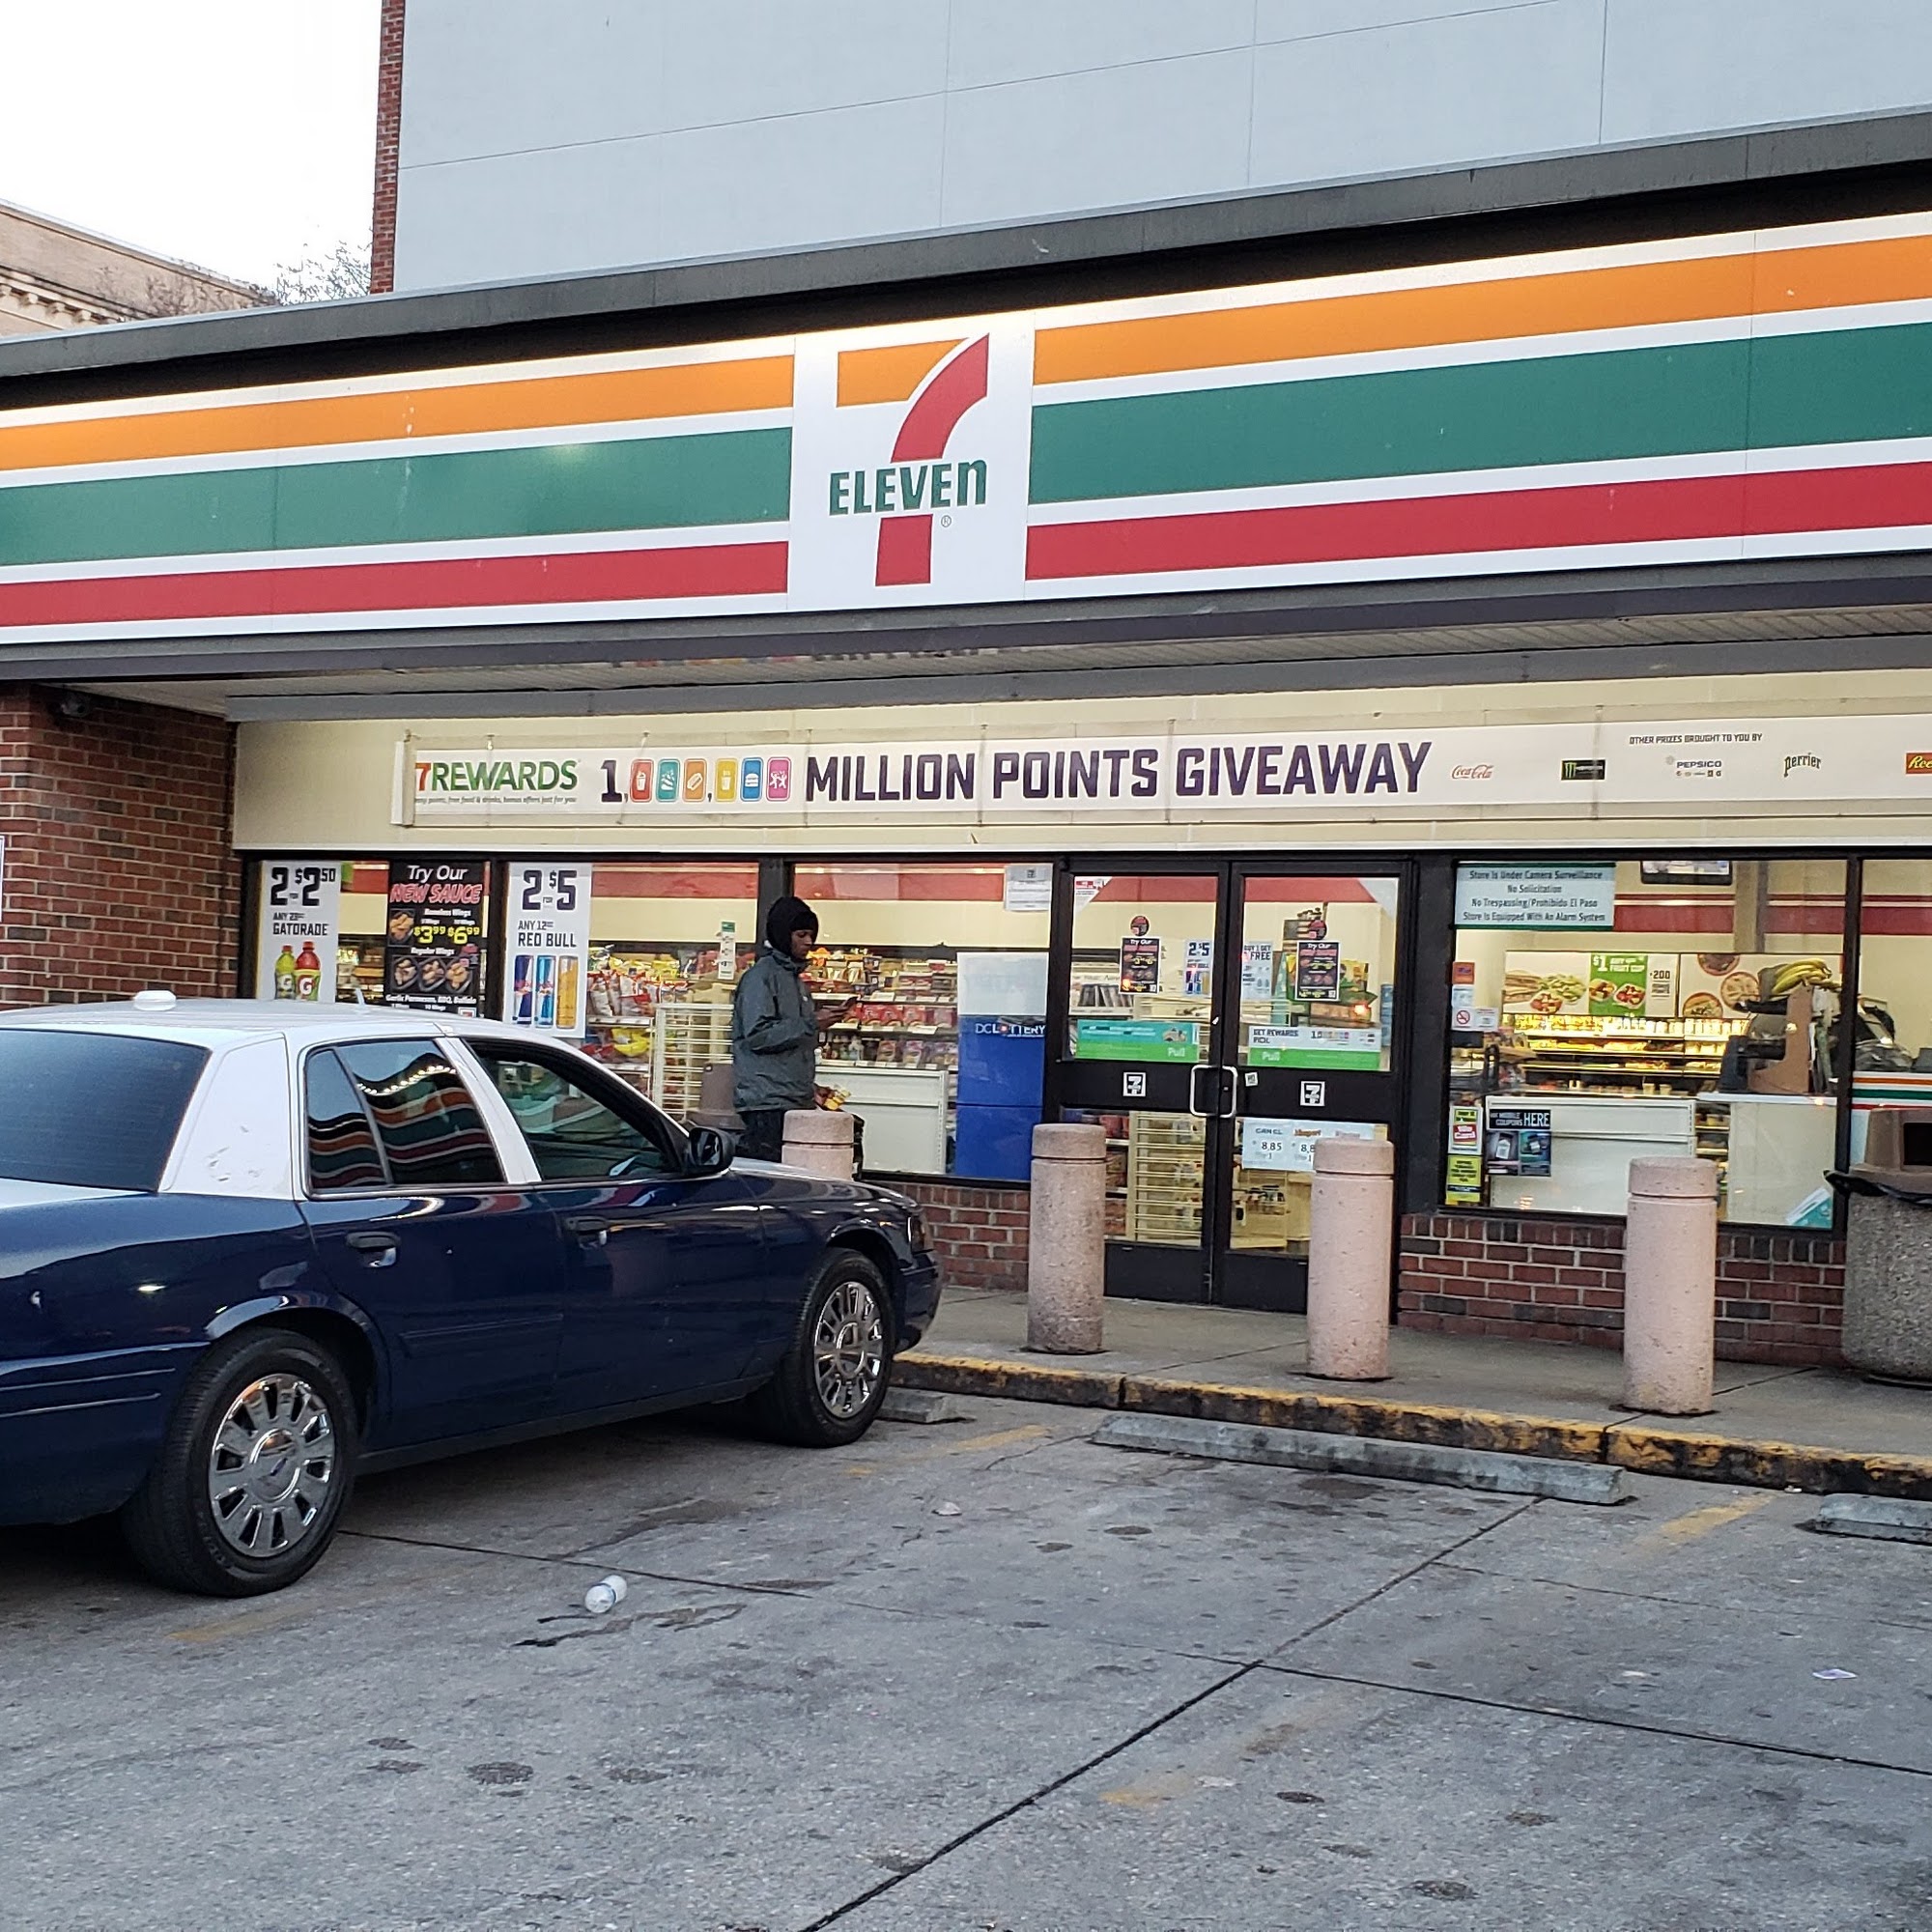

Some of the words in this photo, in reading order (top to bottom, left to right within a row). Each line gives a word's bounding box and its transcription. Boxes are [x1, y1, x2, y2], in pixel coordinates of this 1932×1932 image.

[1629, 736, 1655, 745] OTHER
[1656, 735, 1683, 744] PRIZES
[1684, 734, 1720, 743] BROUGHT
[1676, 760, 1722, 769] PEPSICO
[806, 753, 976, 802] MILLION
[992, 749, 1158, 799] POINTS
[1176, 741, 1433, 797] GIVEAWAY
[407, 866, 434, 883] Try
[436, 866, 469, 880] Our
[1469, 870, 1490, 880] Store
[1500, 870, 1523, 879] Under
[1524, 870, 1552, 880] Camera
[1554, 870, 1603, 880] Surveillance
[270, 867, 289, 906] 2
[522, 869, 543, 911] 2
[1507, 884, 1518, 894] No
[1519, 884, 1562, 894] Solicitation
[389, 883, 431, 903] NEW
[429, 883, 483, 904] SAUCE
[1471, 898, 1483, 907] No
[1570, 898, 1577, 907] El
[1579, 898, 1598, 908] Paso
[1463, 912, 1483, 921] Store
[1492, 912, 1525, 922] Equipped
[1555, 912, 1577, 921] Alarm
[1578, 912, 1605, 923] System
[272, 922, 330, 936] GATORADE
[518, 920, 536, 930] ANY
[518, 932, 542, 947] RED
[546, 933, 578, 948] BULL
[1188, 942, 1197, 956] 2
[1250, 952, 1271, 960] FREE
[1167, 1046, 1185, 1057] Pull
[1262, 1051, 1281, 1062] Pull
[1523, 1112, 1550, 1127] HERE
